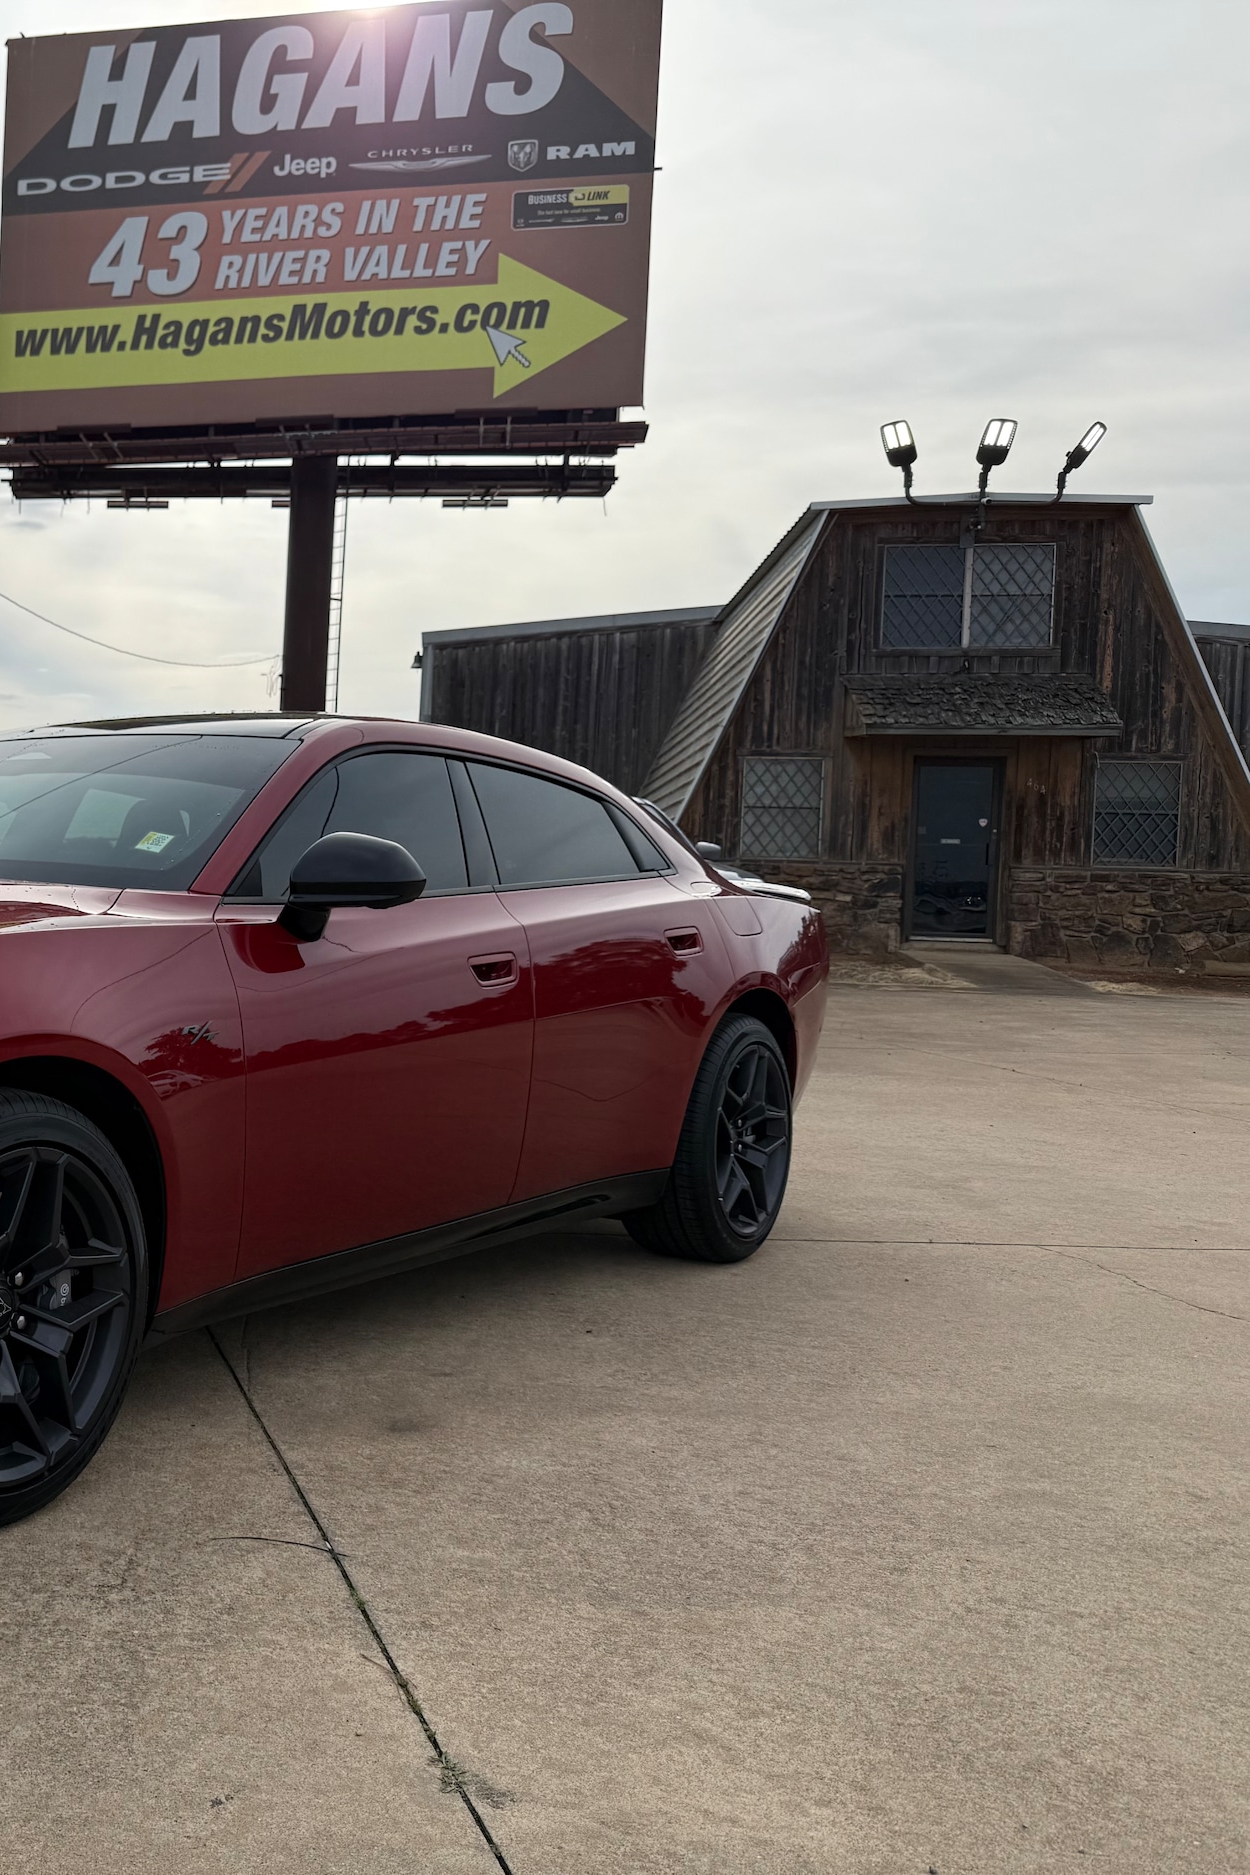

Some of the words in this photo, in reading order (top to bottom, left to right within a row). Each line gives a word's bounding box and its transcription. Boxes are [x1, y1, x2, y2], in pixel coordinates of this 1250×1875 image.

[67, 2, 574, 149] HAGANS
[273, 154, 337, 178] Jeep
[367, 144, 474, 159] CHRYSLER
[546, 141, 636, 160] RAM
[17, 162, 232, 196] DODGE
[528, 193, 568, 205] BUSINESS
[587, 190, 611, 201] LINK
[220, 202, 345, 245] YEARS
[355, 198, 403, 236] IN
[412, 193, 488, 233] THE
[88, 211, 209, 298] 43
[214, 248, 331, 291] RIVER
[343, 239, 492, 283] VALLEY
[14, 299, 550, 358] www.HagansMotors.com
[181, 1020, 220, 1045] R/T
